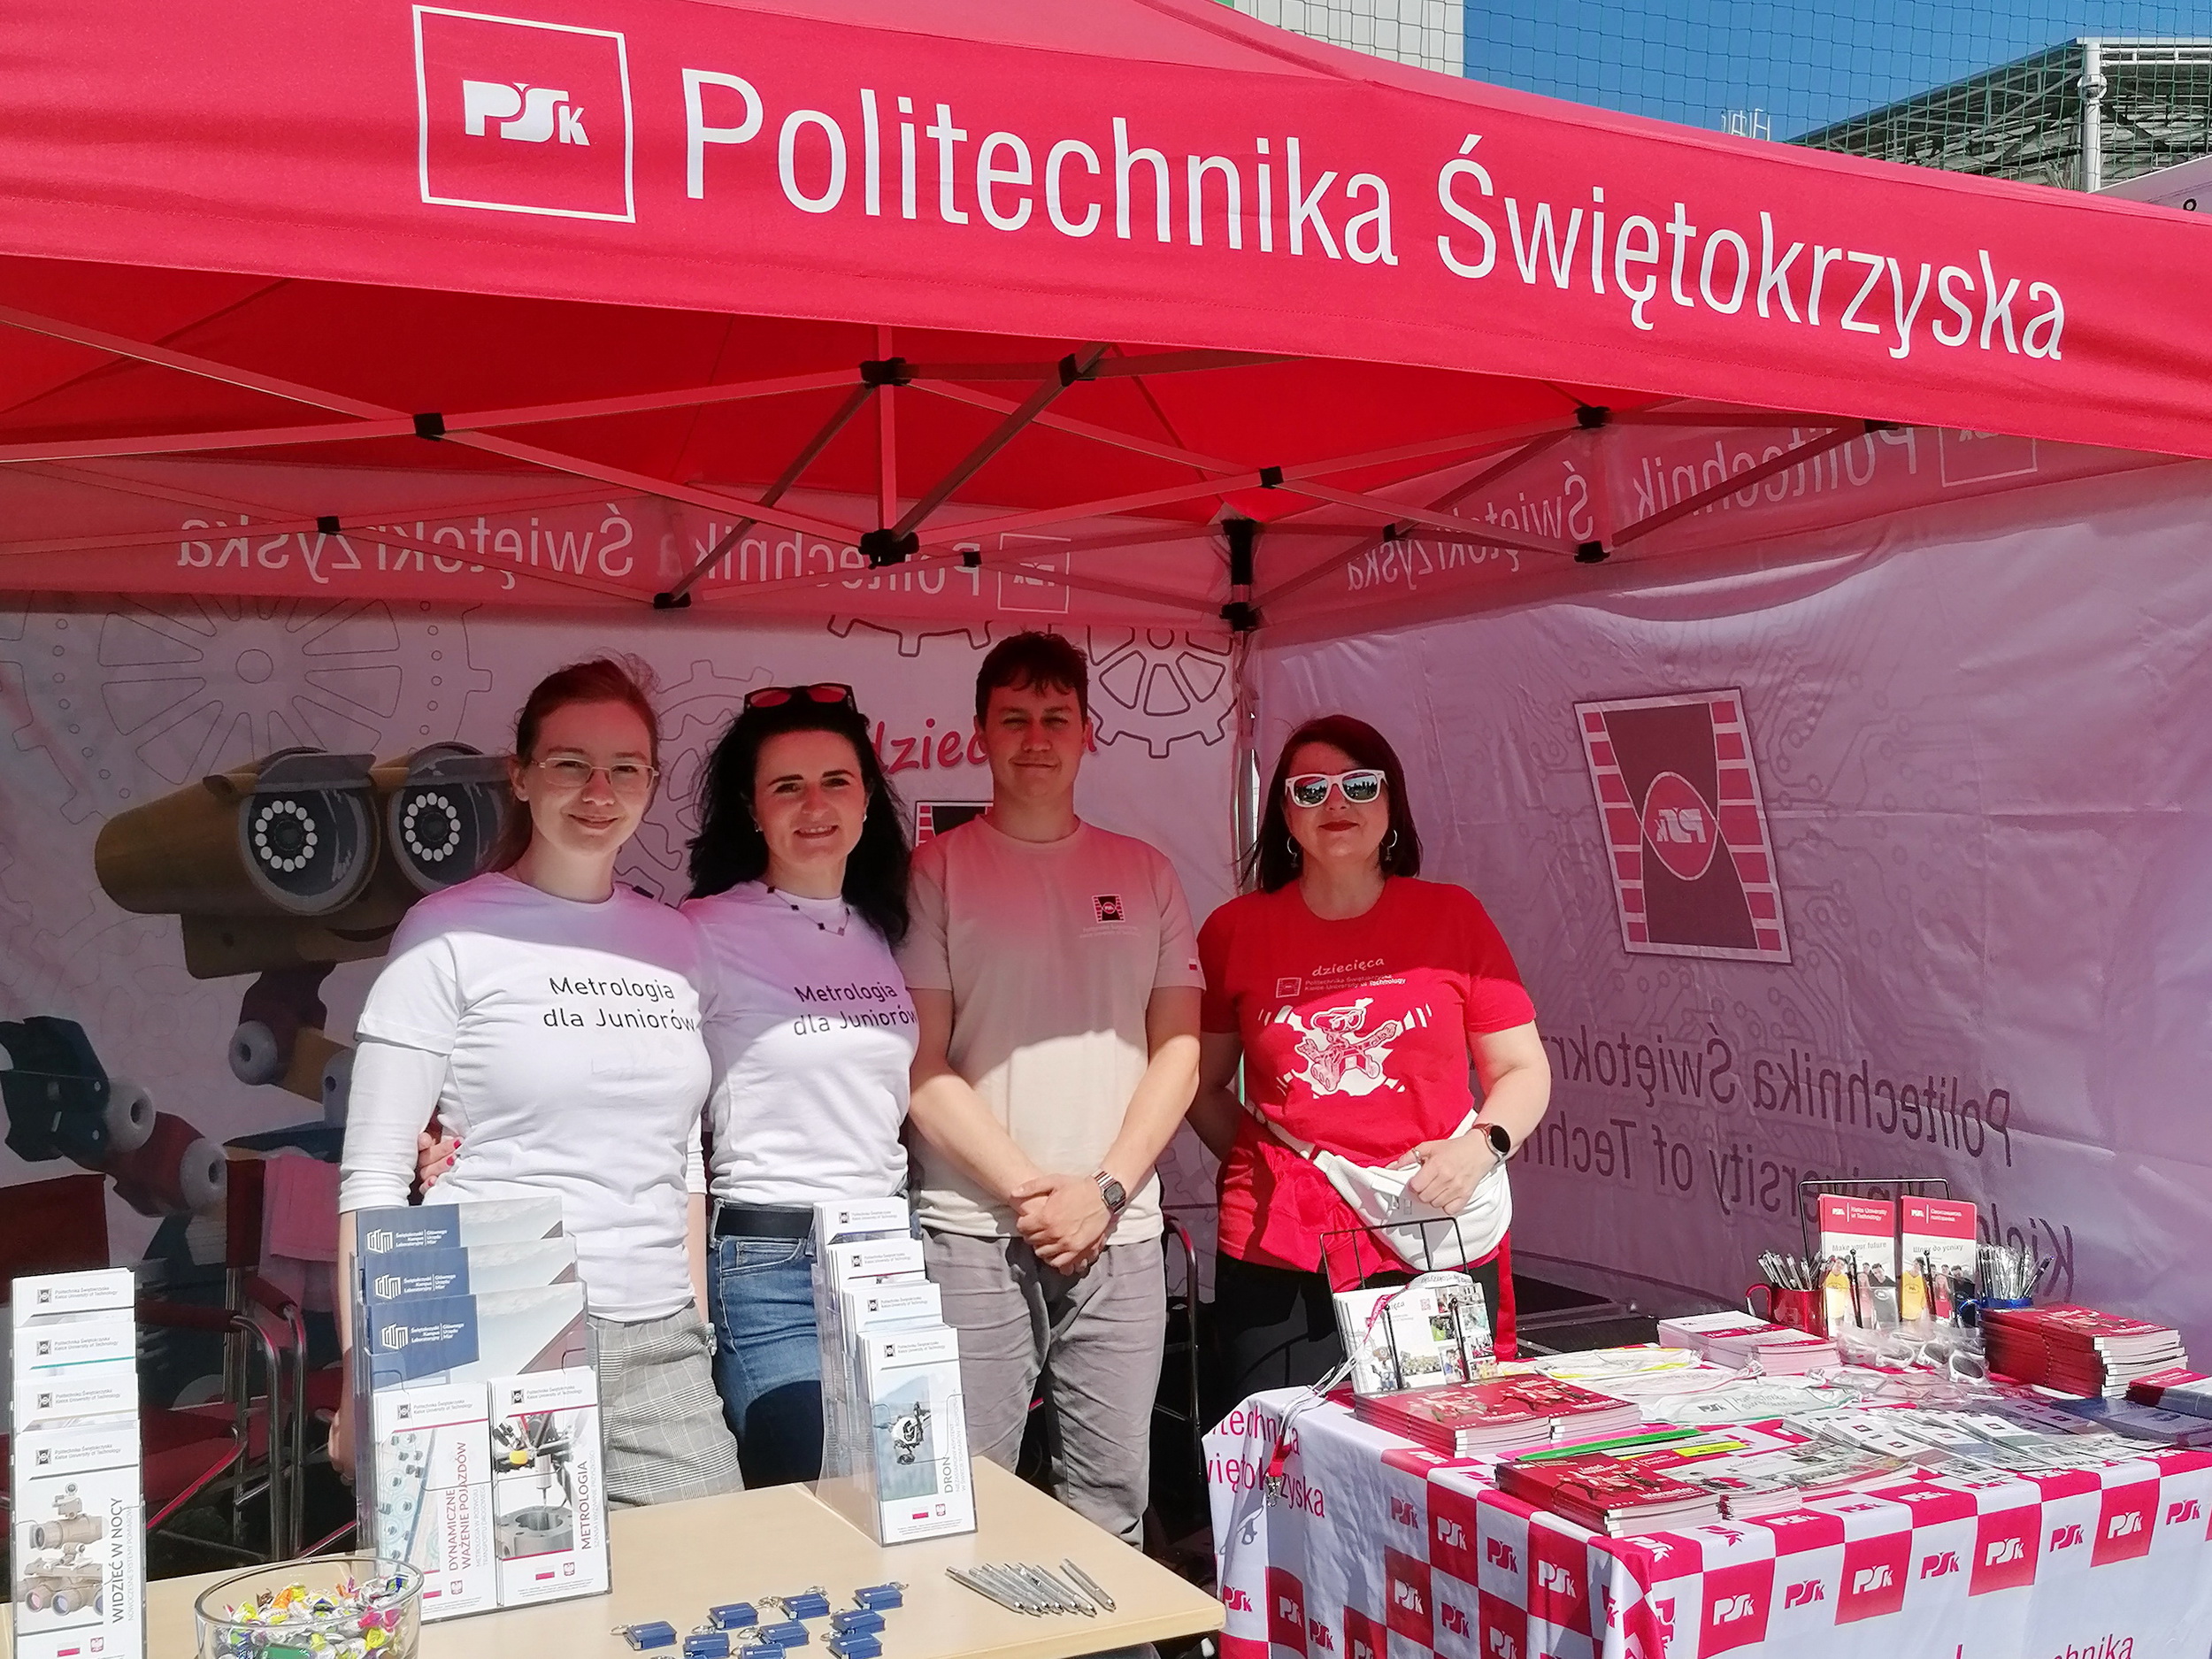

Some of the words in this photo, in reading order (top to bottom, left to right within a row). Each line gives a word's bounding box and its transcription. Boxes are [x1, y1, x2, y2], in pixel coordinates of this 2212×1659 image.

[681, 68, 1398, 267] Politechnika
[1438, 134, 2064, 361] Świętokrzyska
[1311, 957, 1385, 977] dziecięca
[549, 976, 676, 1003] Metrologia
[794, 980, 898, 1005] Metrologia
[542, 1009, 584, 1028] dla
[595, 1008, 696, 1033] Juniorów
[794, 1015, 830, 1036] dla
[455, 1442, 469, 1510] POJAZDÓW
[942, 1456, 953, 1494] DRON
[111, 1497, 123, 1539] NOCY
[577, 1461, 591, 1550] METROLOGIA
[111, 1543, 123, 1557] W
[446, 1489, 458, 1571] DYNAMICZNE
[459, 1513, 472, 1570] WAŻENIE
[109, 1561, 124, 1624] WIDZIEĆ
